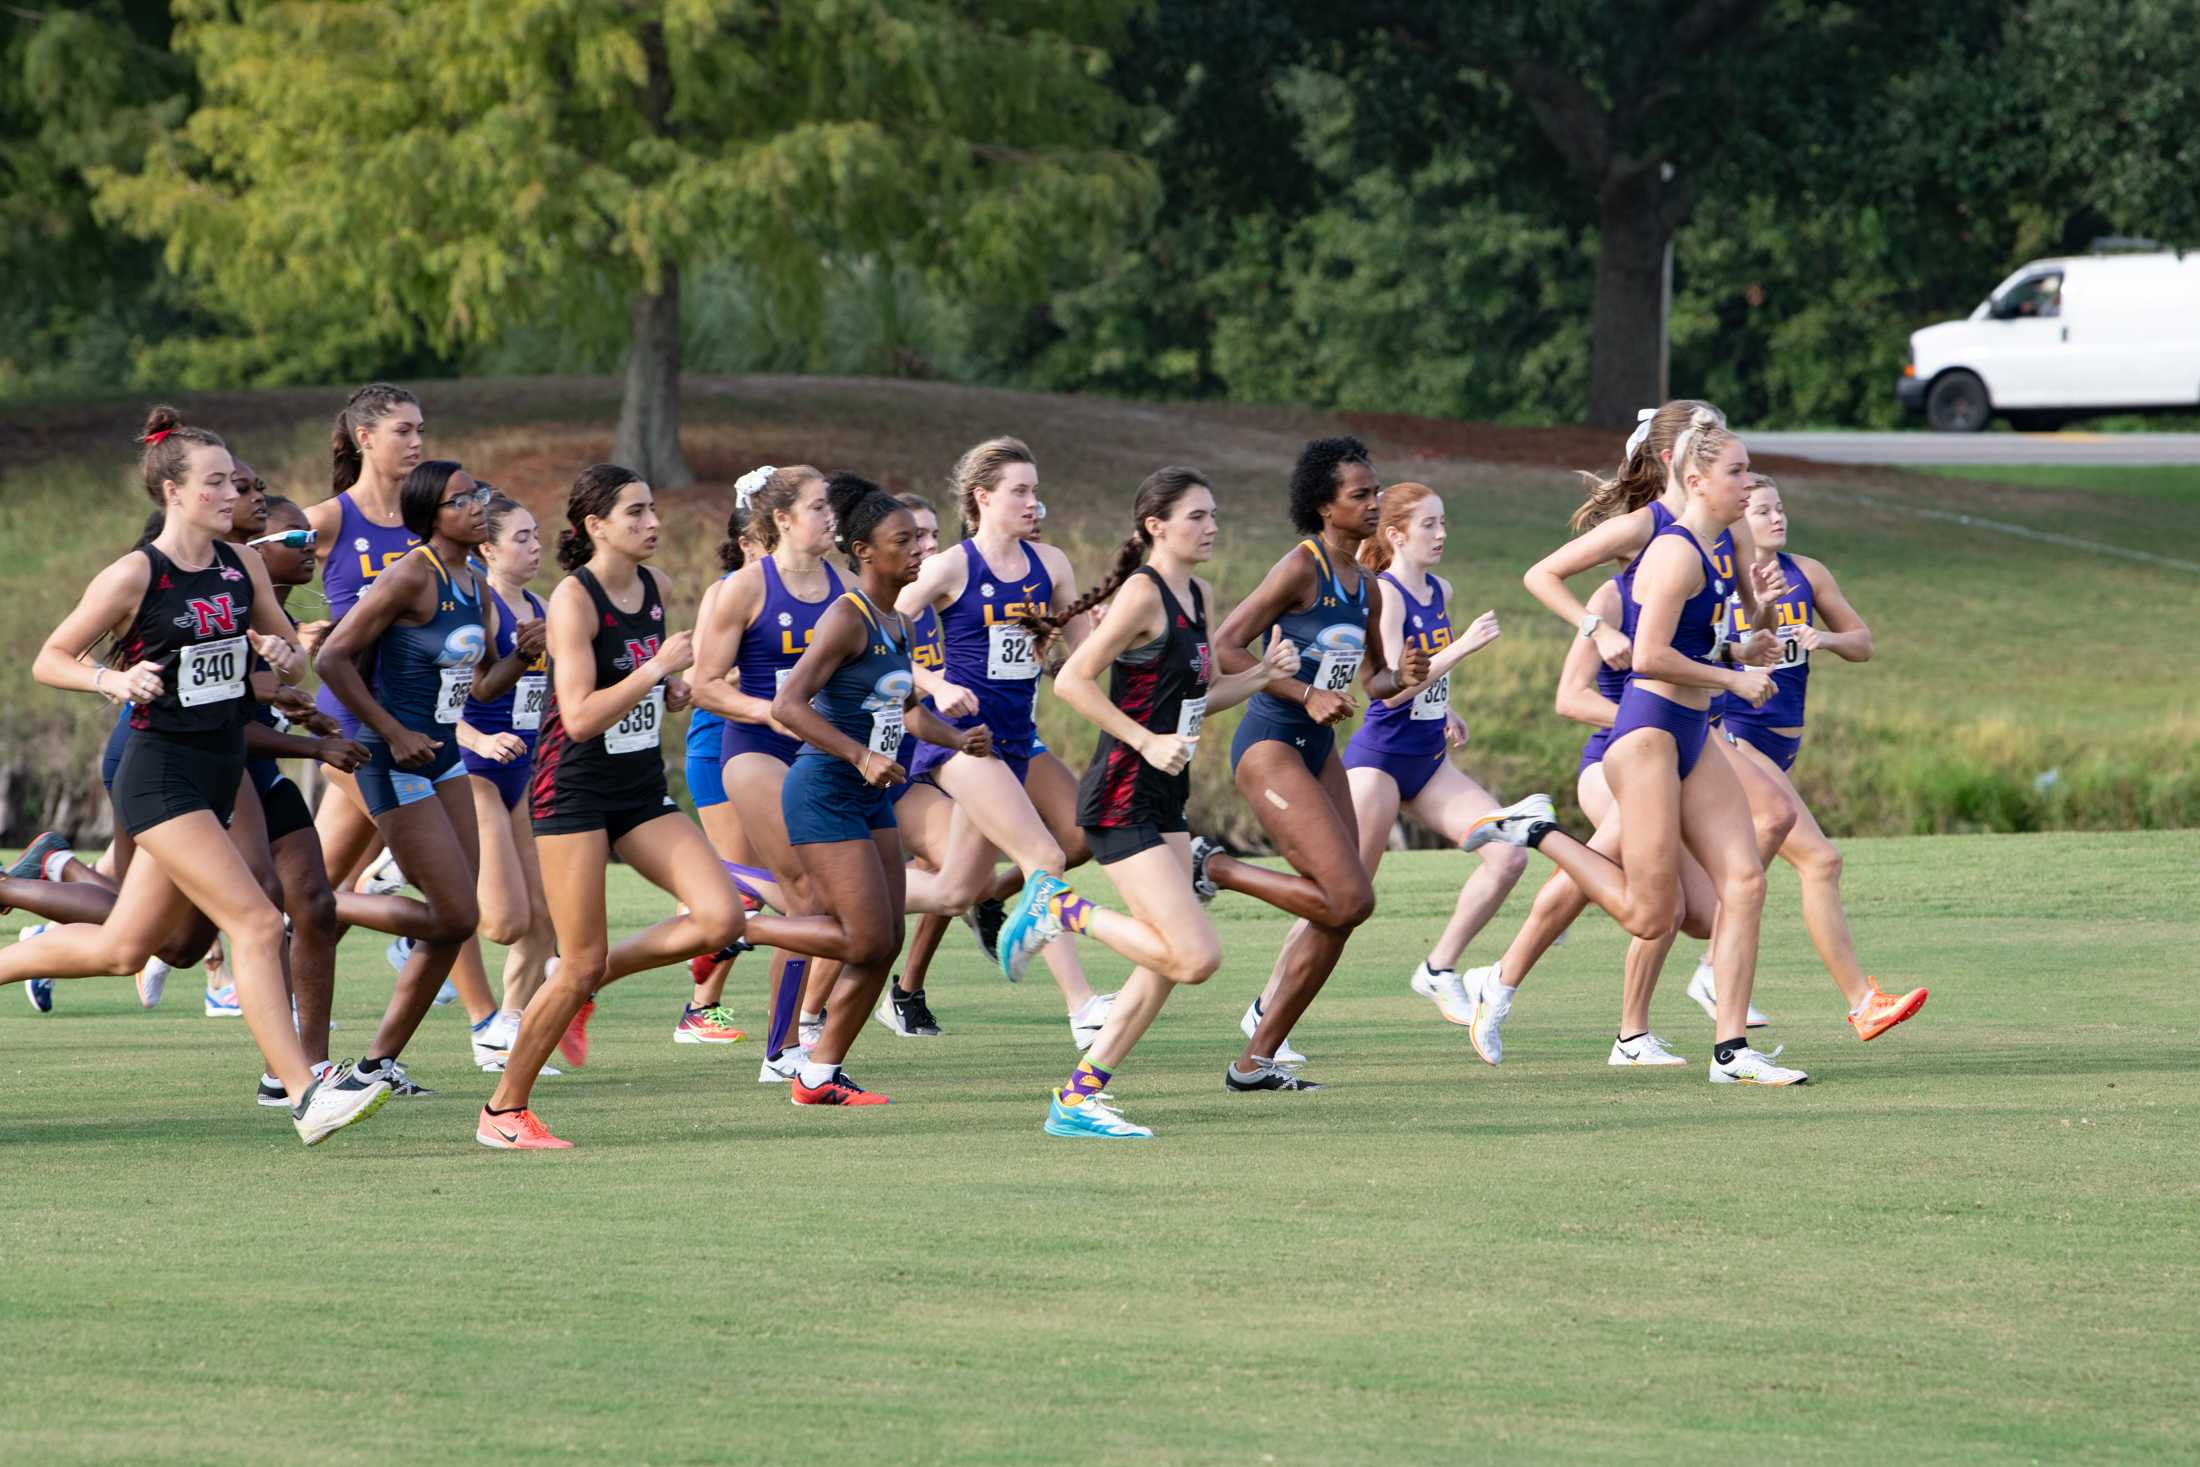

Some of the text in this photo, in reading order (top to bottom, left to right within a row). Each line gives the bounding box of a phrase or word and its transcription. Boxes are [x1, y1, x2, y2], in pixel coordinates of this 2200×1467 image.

[192, 652, 235, 686] 340
[1327, 664, 1357, 690] 354
[448, 681, 473, 708] 35
[1425, 677, 1448, 704] 326
[619, 702, 655, 734] 339
[880, 725, 901, 752] 35
